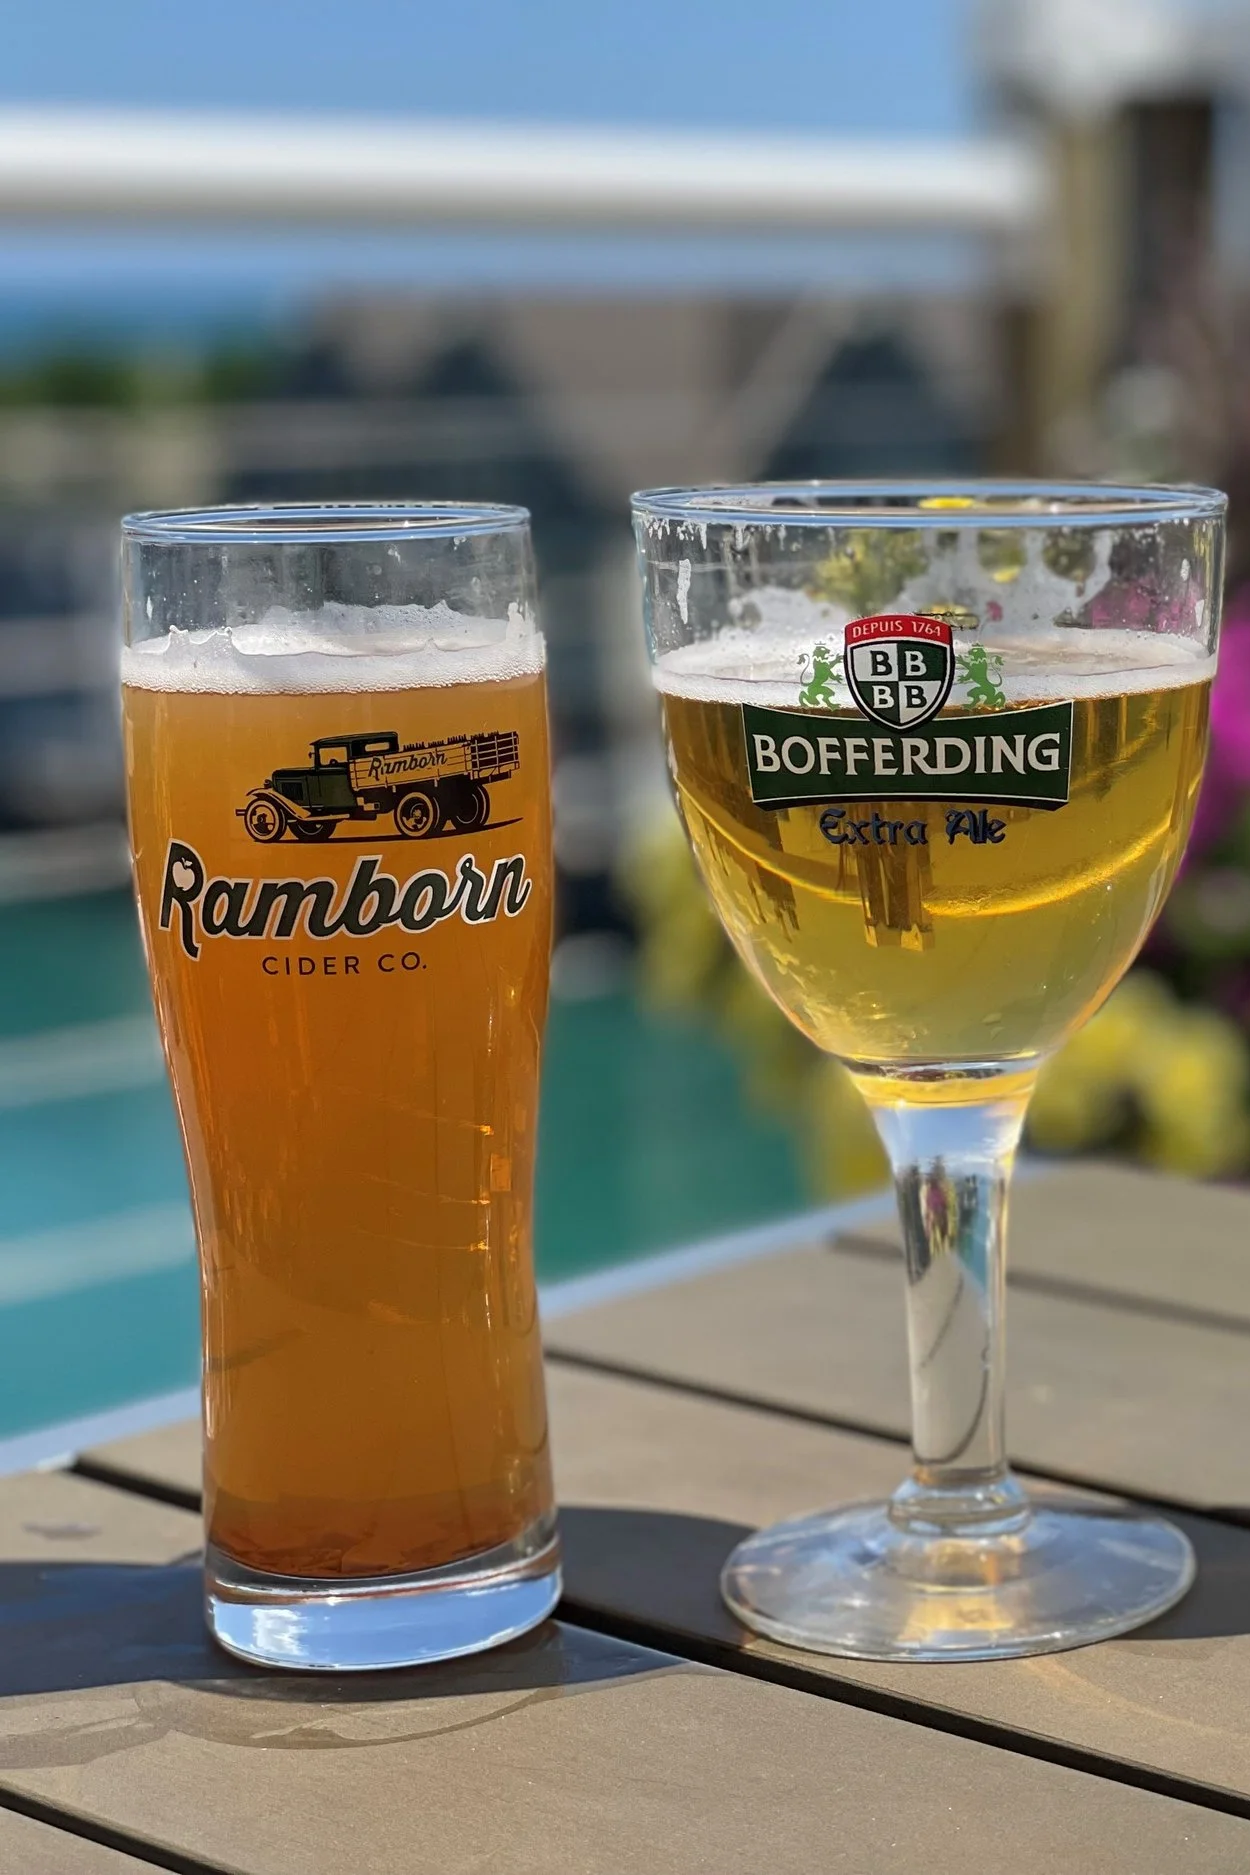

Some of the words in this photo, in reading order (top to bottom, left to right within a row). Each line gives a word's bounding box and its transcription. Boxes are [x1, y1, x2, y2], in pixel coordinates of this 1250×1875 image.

[852, 620, 903, 638] DEPUIS
[911, 620, 941, 636] 1764
[368, 751, 448, 781] Ramborn
[752, 732, 1061, 776] BOFFERDING
[819, 808, 927, 846] Extra
[945, 808, 1007, 846] Ale
[158, 837, 532, 962] Ramborn
[262, 955, 360, 976] CIDER
[378, 951, 427, 974] CO.
